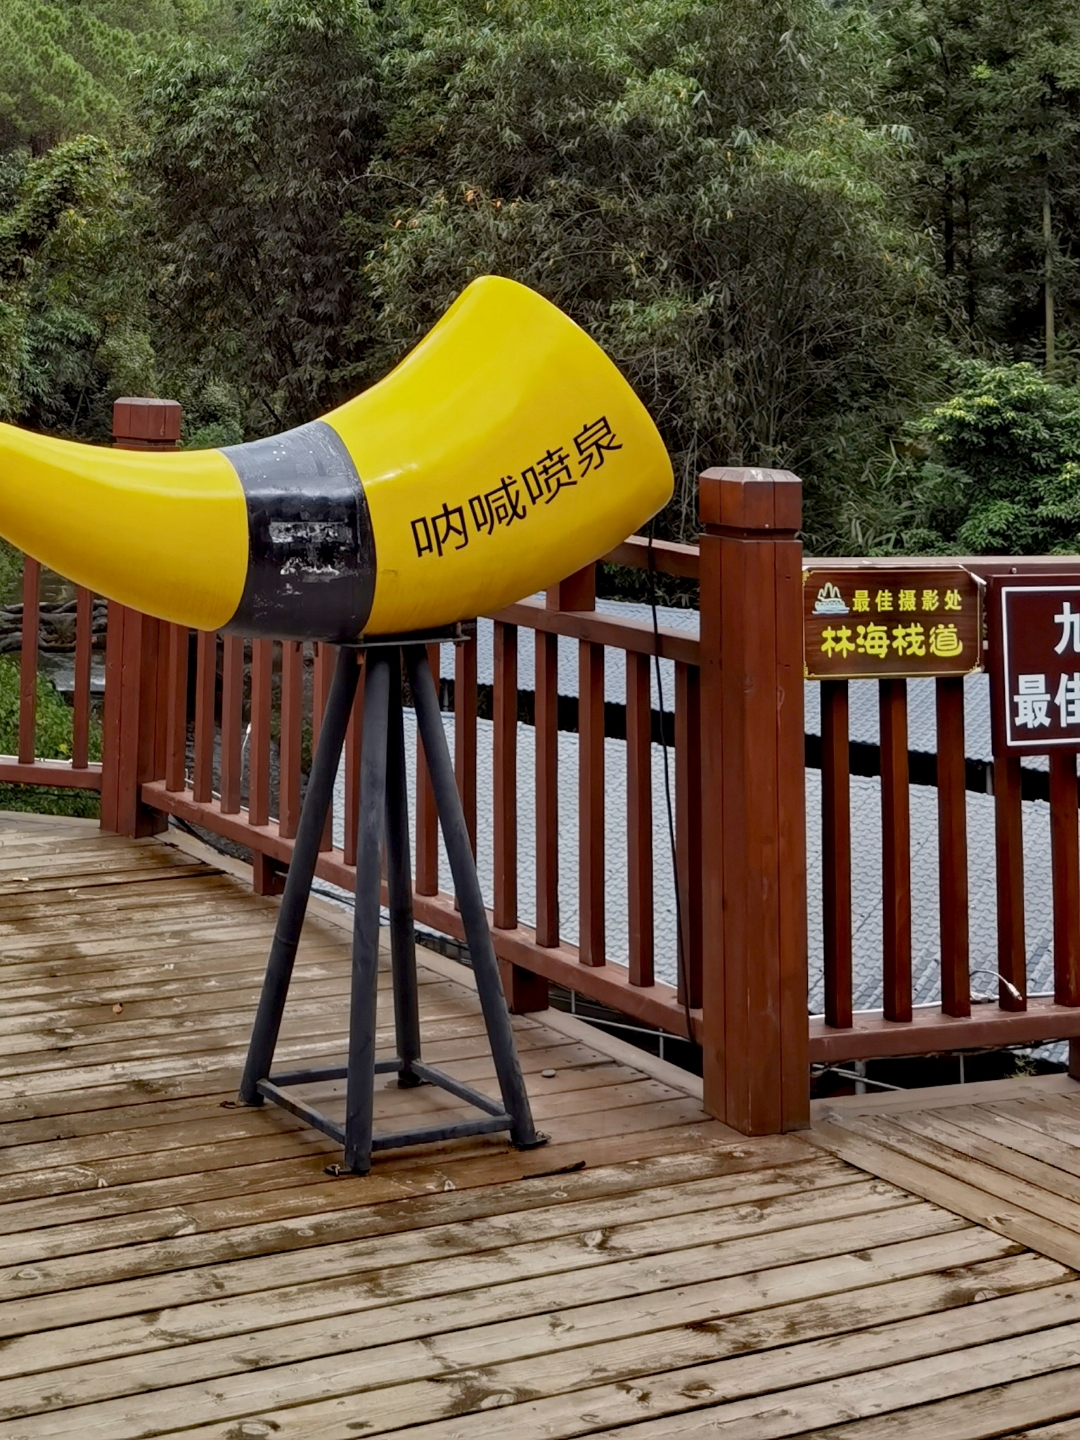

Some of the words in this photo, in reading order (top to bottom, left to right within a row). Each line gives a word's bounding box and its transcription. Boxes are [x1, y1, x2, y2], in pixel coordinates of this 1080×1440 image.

[410, 415, 624, 559] 呐喊喷泉
[852, 589, 962, 612] 最佳摄影处
[821, 622, 963, 659] 林海栈道
